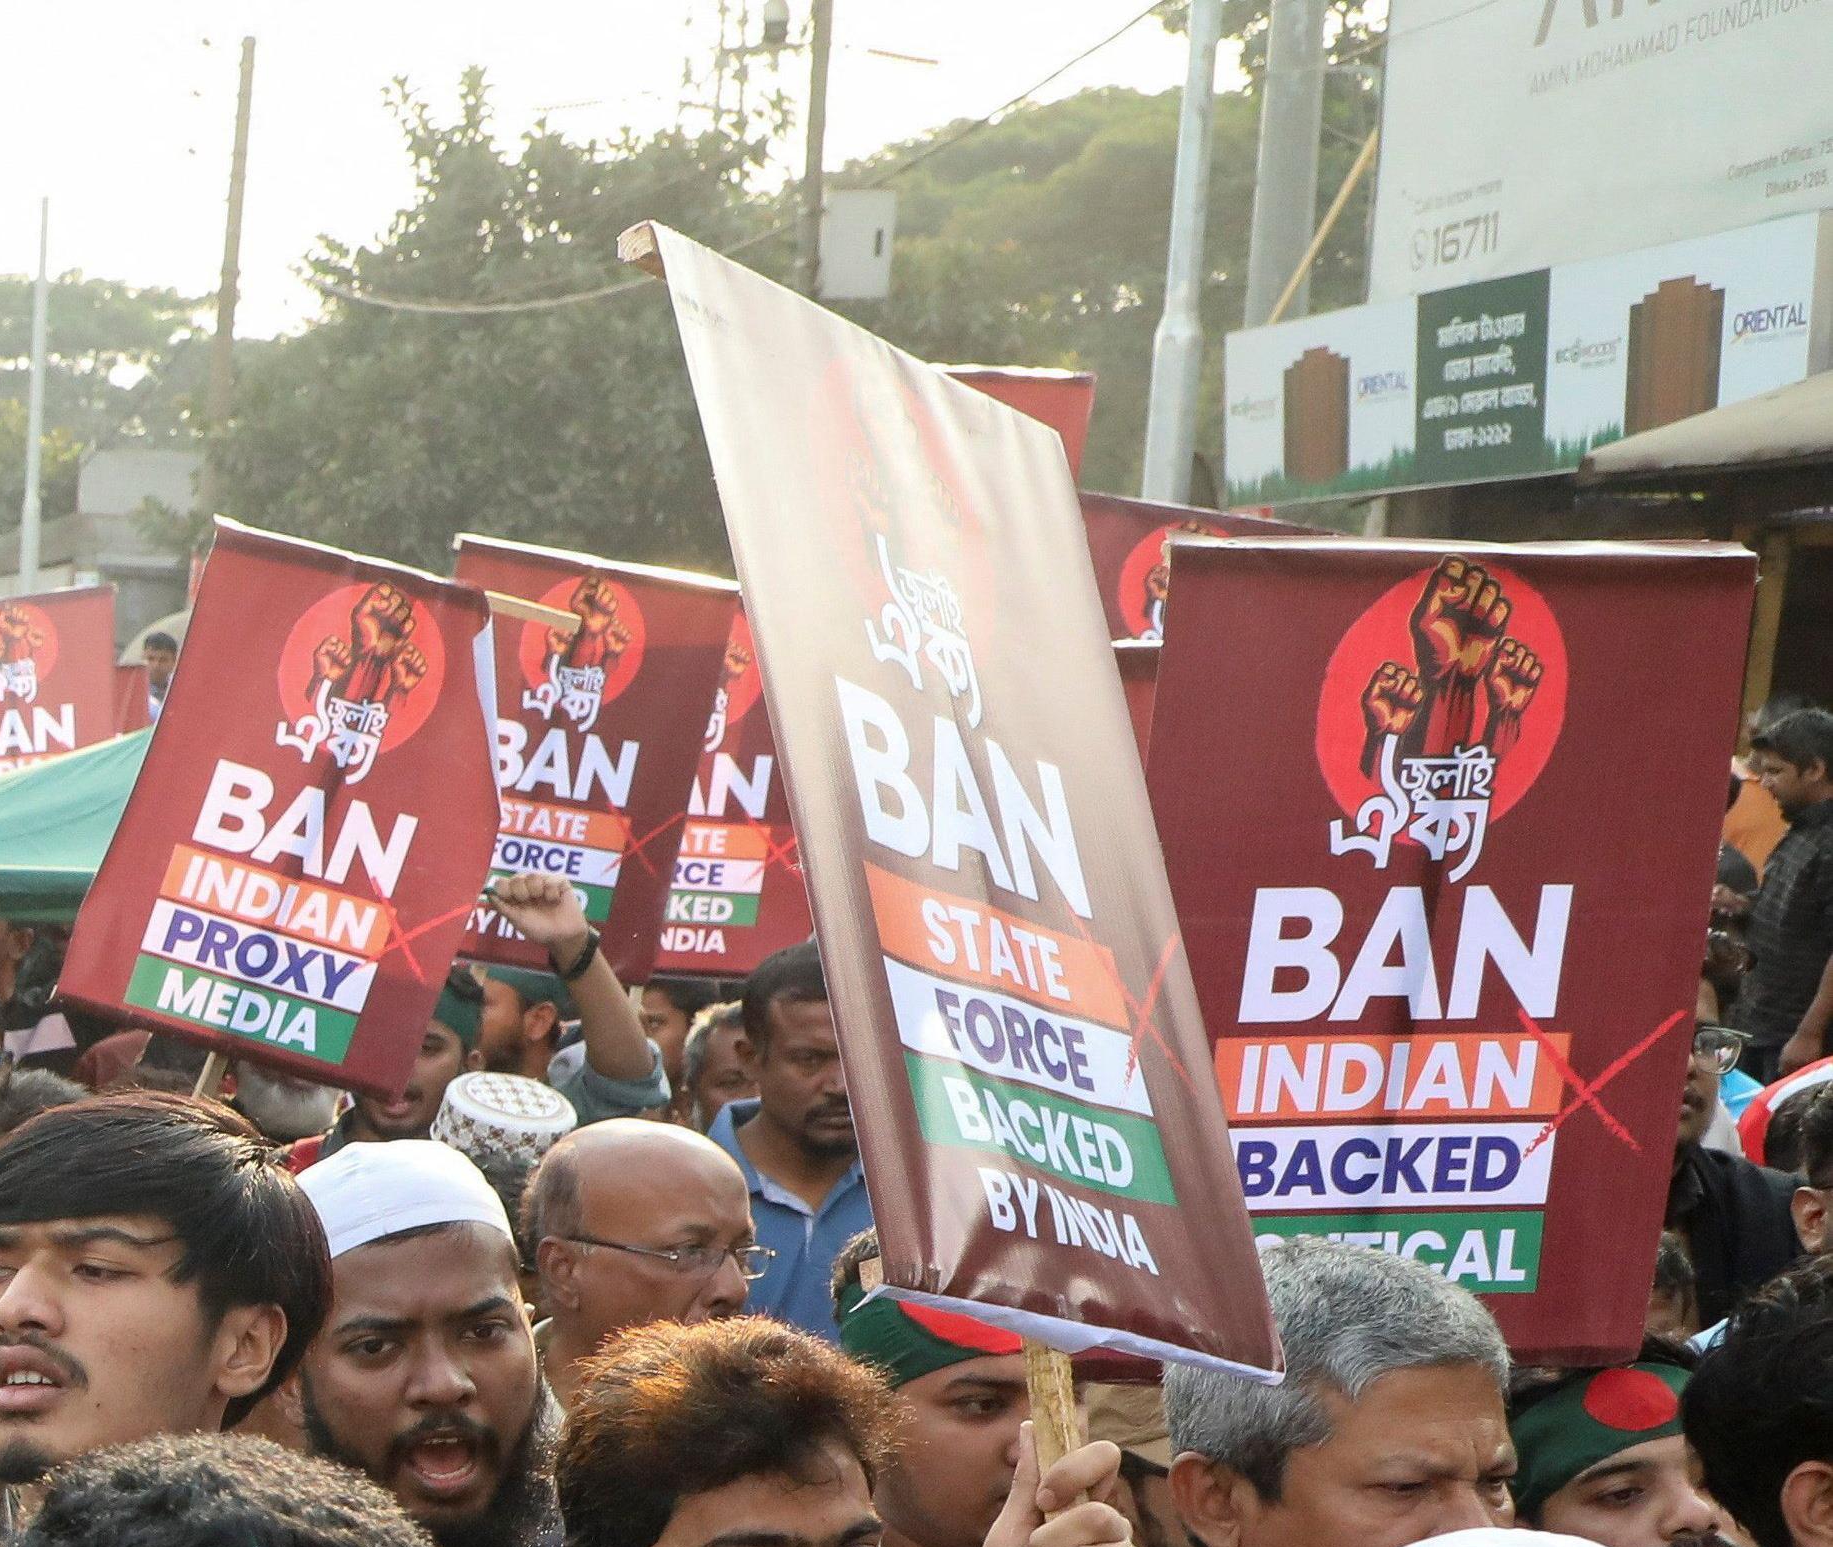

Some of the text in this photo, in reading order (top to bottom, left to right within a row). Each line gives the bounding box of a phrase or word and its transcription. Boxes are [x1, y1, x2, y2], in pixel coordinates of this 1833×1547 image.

[1576, 23, 1679, 79] MOHAMMAD
[1434, 211, 1500, 265] 16711
[1733, 302, 1807, 338] ORIENTAL
[276, 677, 383, 785] ঐক্য
[327, 696, 390, 740] জুলাই
[496, 717, 640, 808] BAN
[836, 674, 1094, 921] BAN
[1329, 733, 1490, 884] ঐক্য
[1399, 744, 1498, 801] জুলাই
[191, 758, 419, 898] BAN
[499, 805, 590, 842] STATE
[179, 849, 381, 950] INDIAN
[659, 926, 727, 954] NDIA
[667, 894, 734, 923] KED
[162, 908, 360, 1001] PROXY
[919, 897, 1071, 1003] STATE
[1237, 883, 1575, 1025] BAN
[154, 970, 318, 1052] MEDIA
[933, 988, 1097, 1094] FORCE
[1235, 1039, 1539, 1115] INDIAN
[942, 1074, 1134, 1190] BACKED
[1238, 1136, 1524, 1200] BACKED
[976, 1166, 1039, 1240] BY
[1050, 1181, 1160, 1278] INDIA
